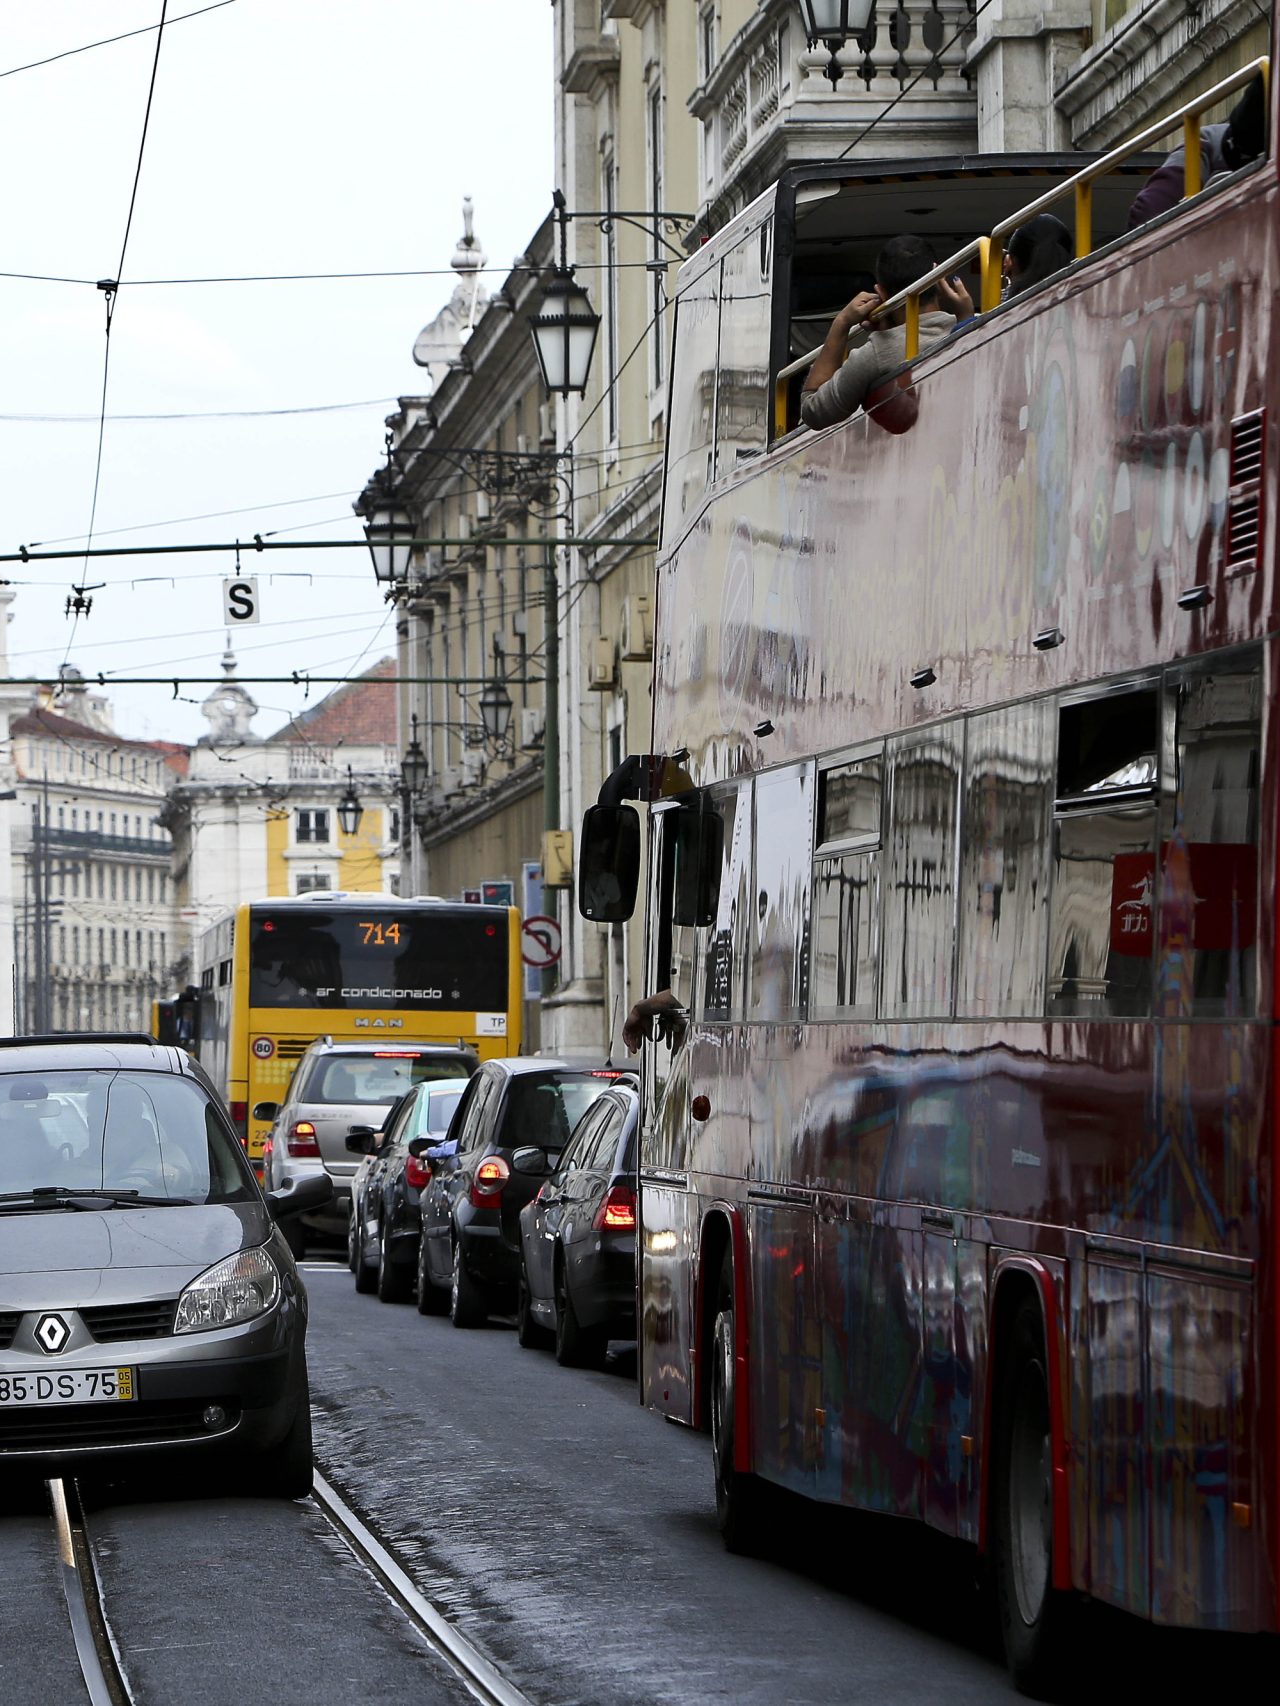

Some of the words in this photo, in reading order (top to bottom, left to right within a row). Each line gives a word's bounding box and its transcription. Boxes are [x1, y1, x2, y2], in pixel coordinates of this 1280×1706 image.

[228, 583, 254, 620] S
[359, 922, 401, 945] 714
[316, 987, 335, 997] ar
[341, 986, 442, 999] condicionado
[354, 1018, 403, 1028] MAN
[491, 1017, 505, 1027] TP
[256, 1043, 271, 1053] 80
[118, 1371, 130, 1381] 05
